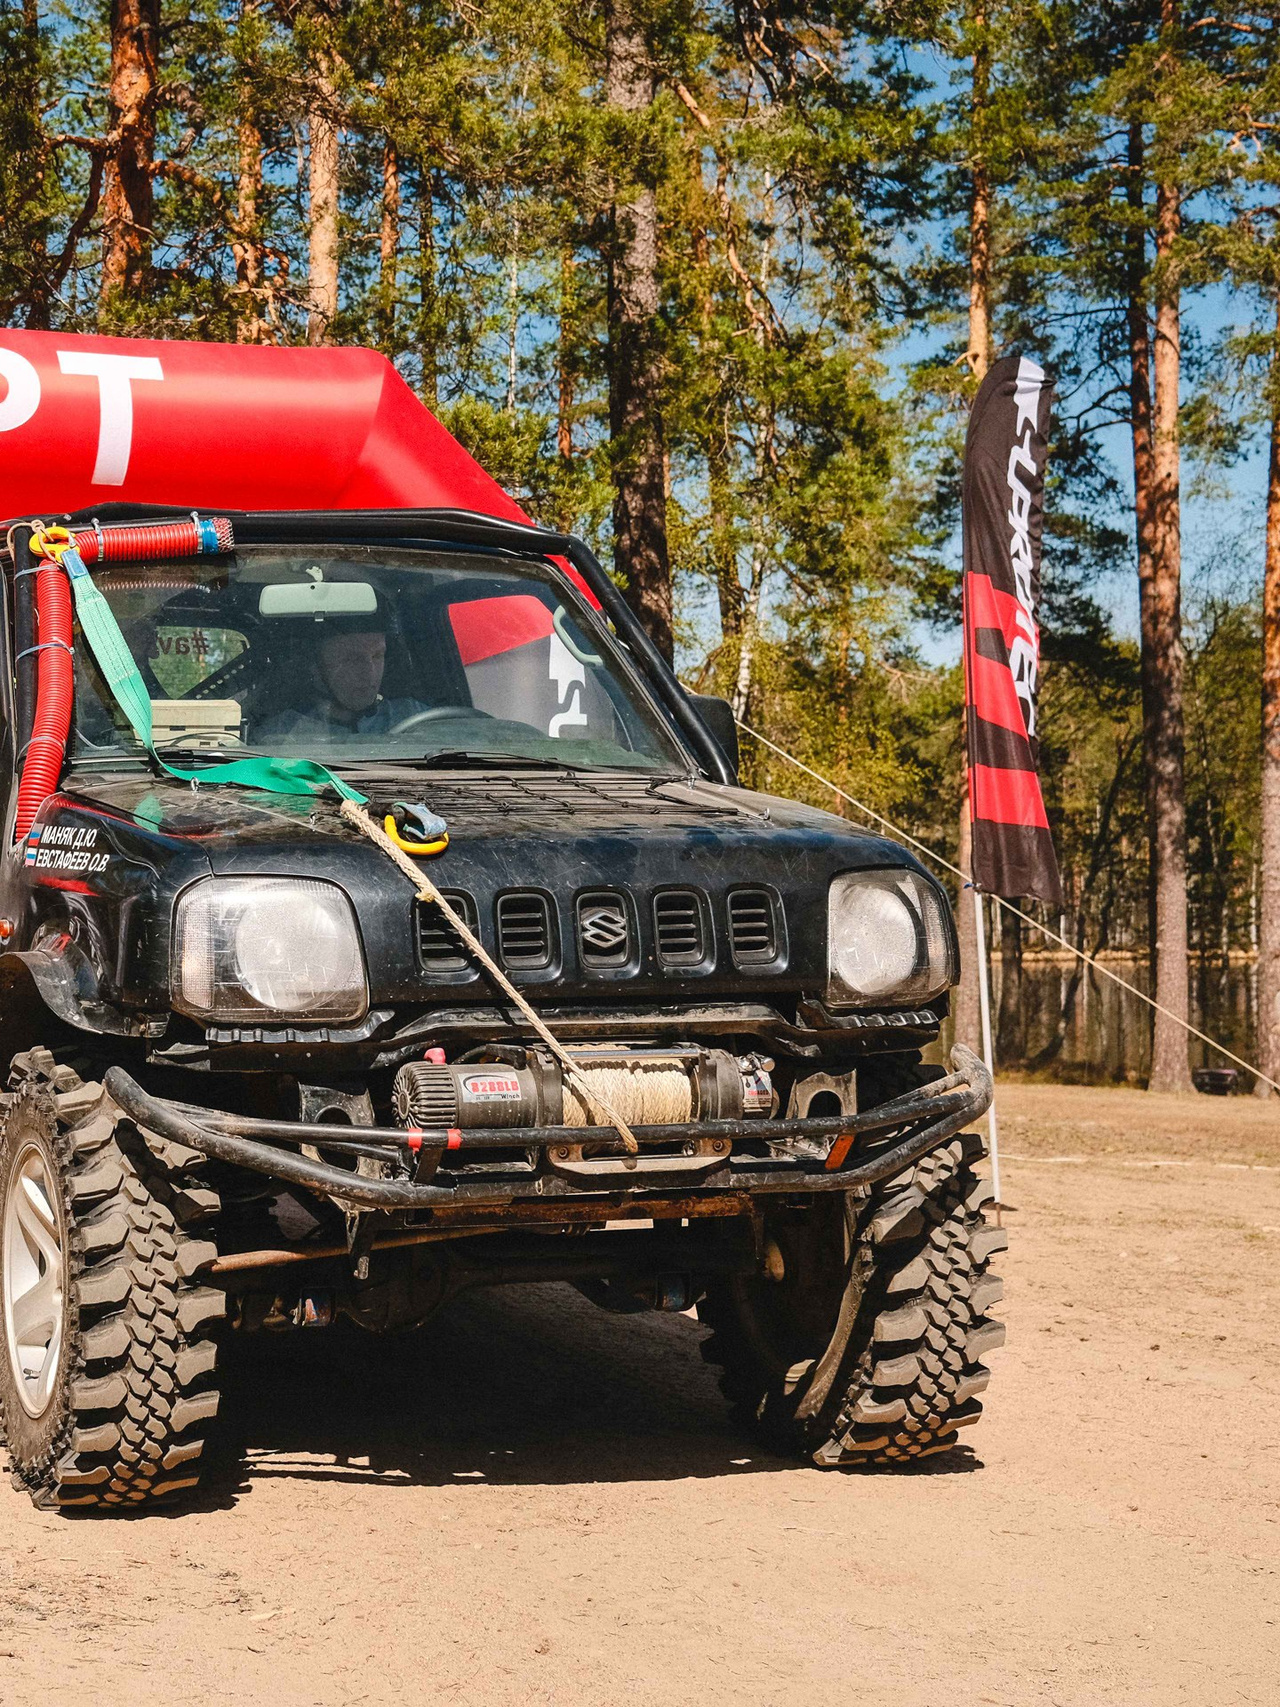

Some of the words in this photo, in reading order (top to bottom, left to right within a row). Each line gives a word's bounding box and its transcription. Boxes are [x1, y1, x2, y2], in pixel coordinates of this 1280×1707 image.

[40, 825, 77, 846] МАНЯК
[72, 827, 97, 850] Д.Ю.
[35, 848, 91, 871] ЕВСТАФЕЕВ
[88, 853, 110, 873] О.В.
